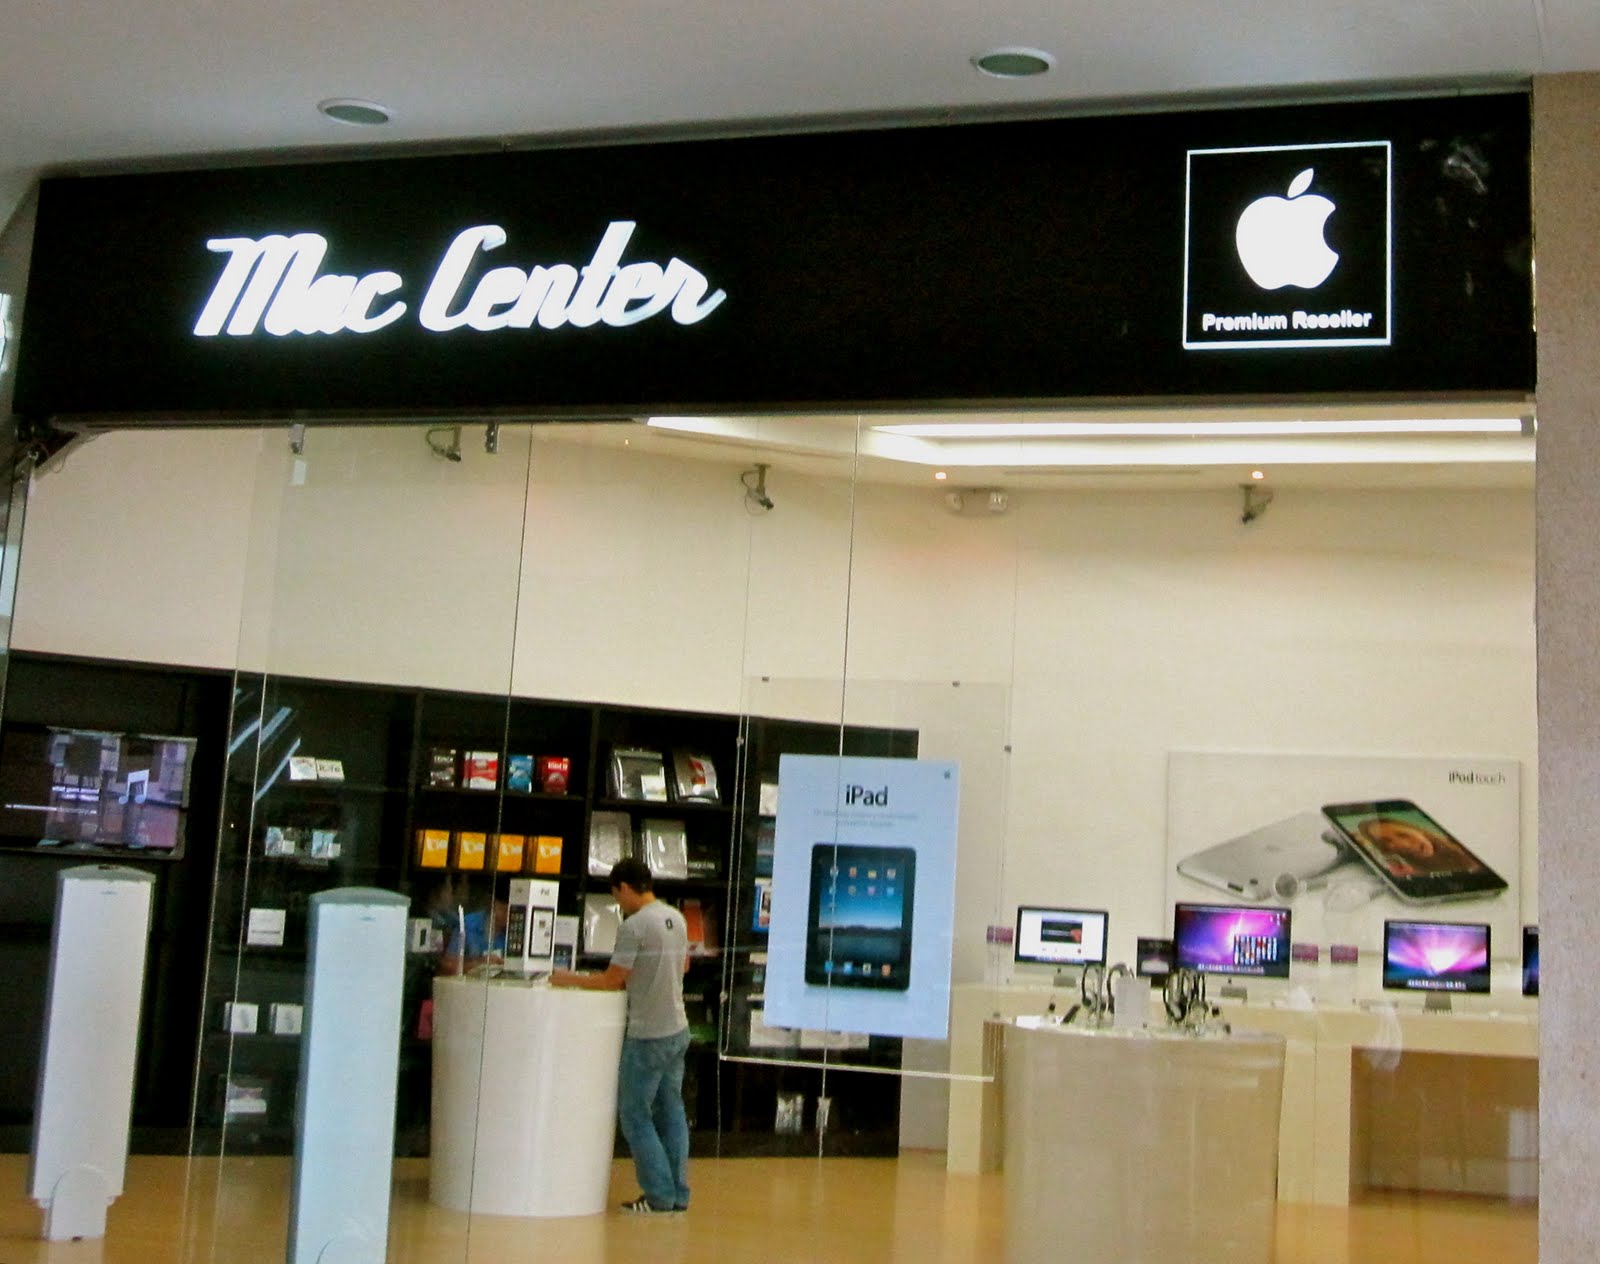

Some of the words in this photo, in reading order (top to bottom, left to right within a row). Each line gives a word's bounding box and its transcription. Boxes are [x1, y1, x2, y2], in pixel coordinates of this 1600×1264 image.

[193, 232, 408, 336] Mac
[418, 220, 727, 331] Center
[1202, 312, 1288, 332] Premium
[1291, 309, 1373, 330] Reseller
[845, 783, 889, 807] iPad
